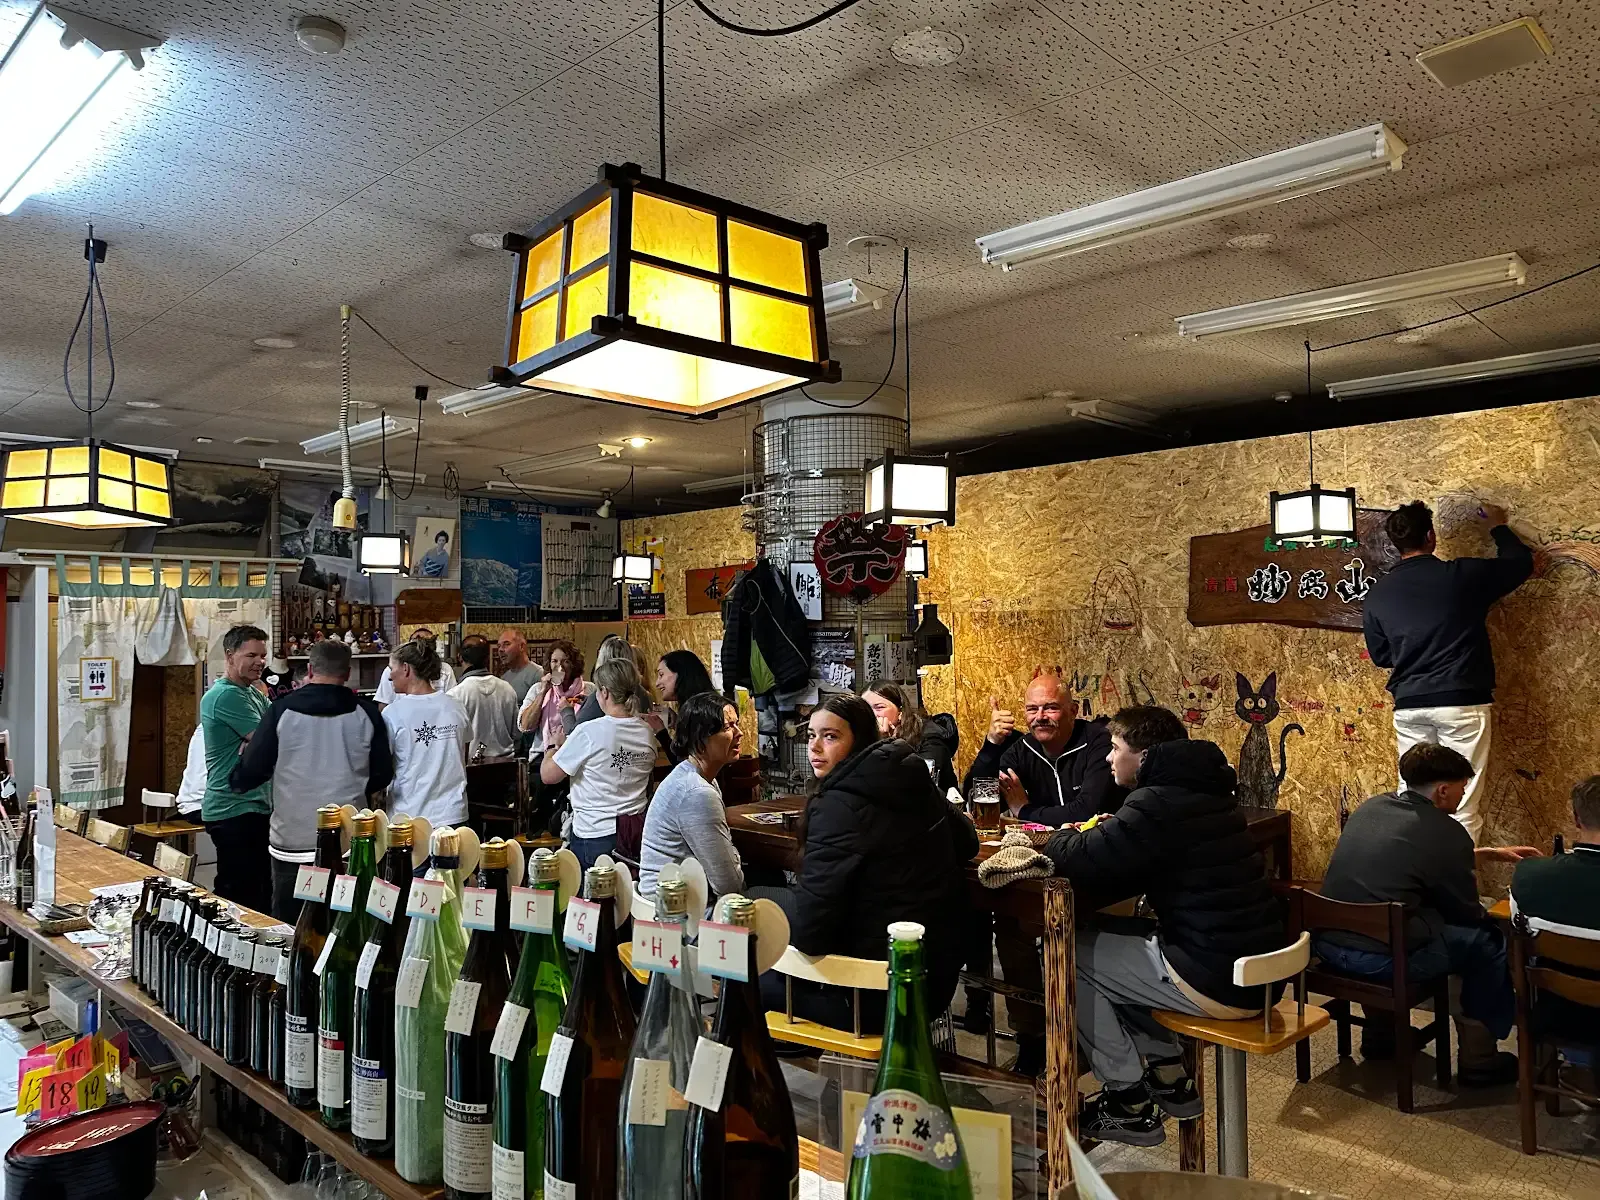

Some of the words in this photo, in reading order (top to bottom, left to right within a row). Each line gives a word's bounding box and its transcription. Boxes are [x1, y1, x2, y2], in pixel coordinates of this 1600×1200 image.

[818, 515, 904, 585] 祭
[302, 875, 313, 892] A
[340, 886, 347, 901] B
[379, 895, 387, 908] C
[420, 891, 428, 908] D
[475, 900, 484, 917] E
[526, 901, 536, 919] F
[577, 912, 587, 934] G
[652, 936, 662, 958] H
[259, 956, 275, 966] 204
[48, 1082, 74, 1109] 18
[84, 1075, 99, 1110] 19
[871, 1113, 932, 1141] 雪中梅
